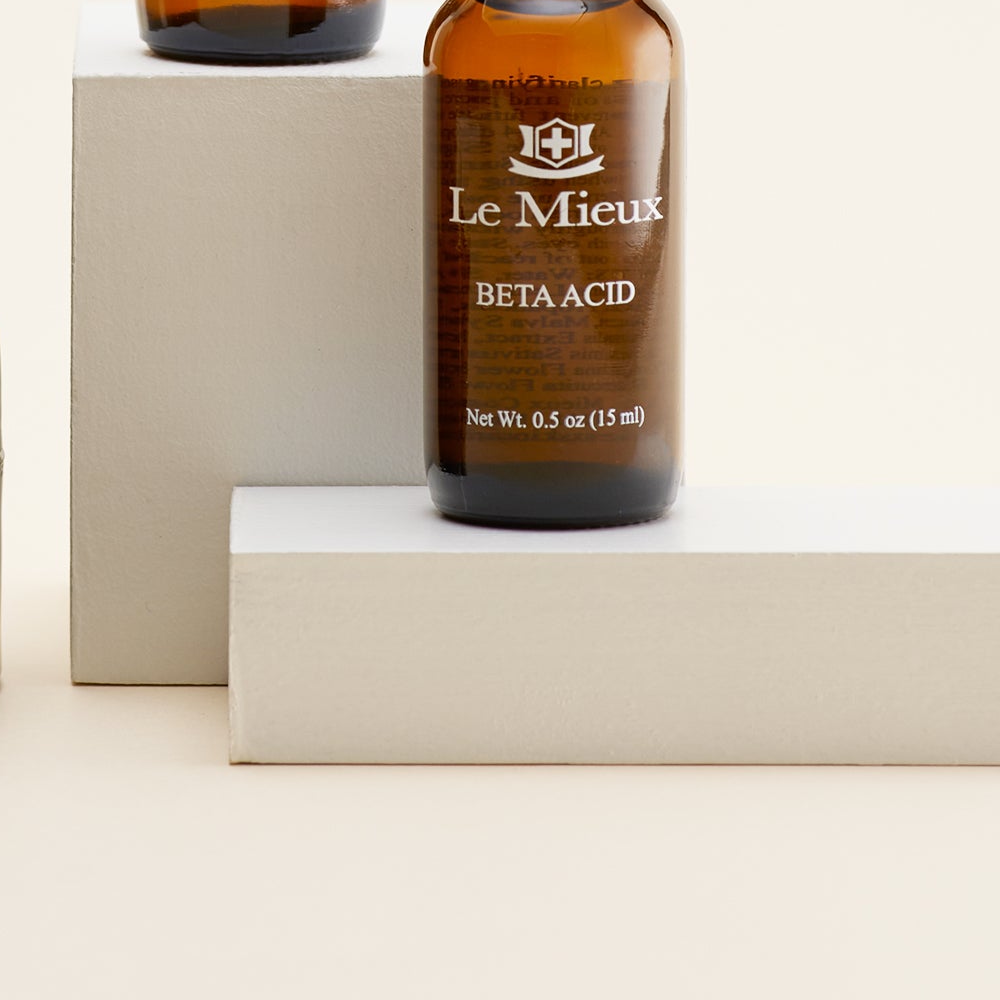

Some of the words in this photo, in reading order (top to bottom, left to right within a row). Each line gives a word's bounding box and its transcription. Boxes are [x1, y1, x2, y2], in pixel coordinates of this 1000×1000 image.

[449, 186, 501, 226] Le
[515, 190, 664, 228] Mieux
[476, 282, 556, 307] BETA
[560, 280, 635, 307] ACID
[466, 408, 493, 427] Net
[497, 410, 526, 429] Wt.
[532, 411, 559, 429] 0.5
[564, 414, 585, 429] oz
[589, 409, 617, 431] (15
[620, 405, 645, 428] ml)
